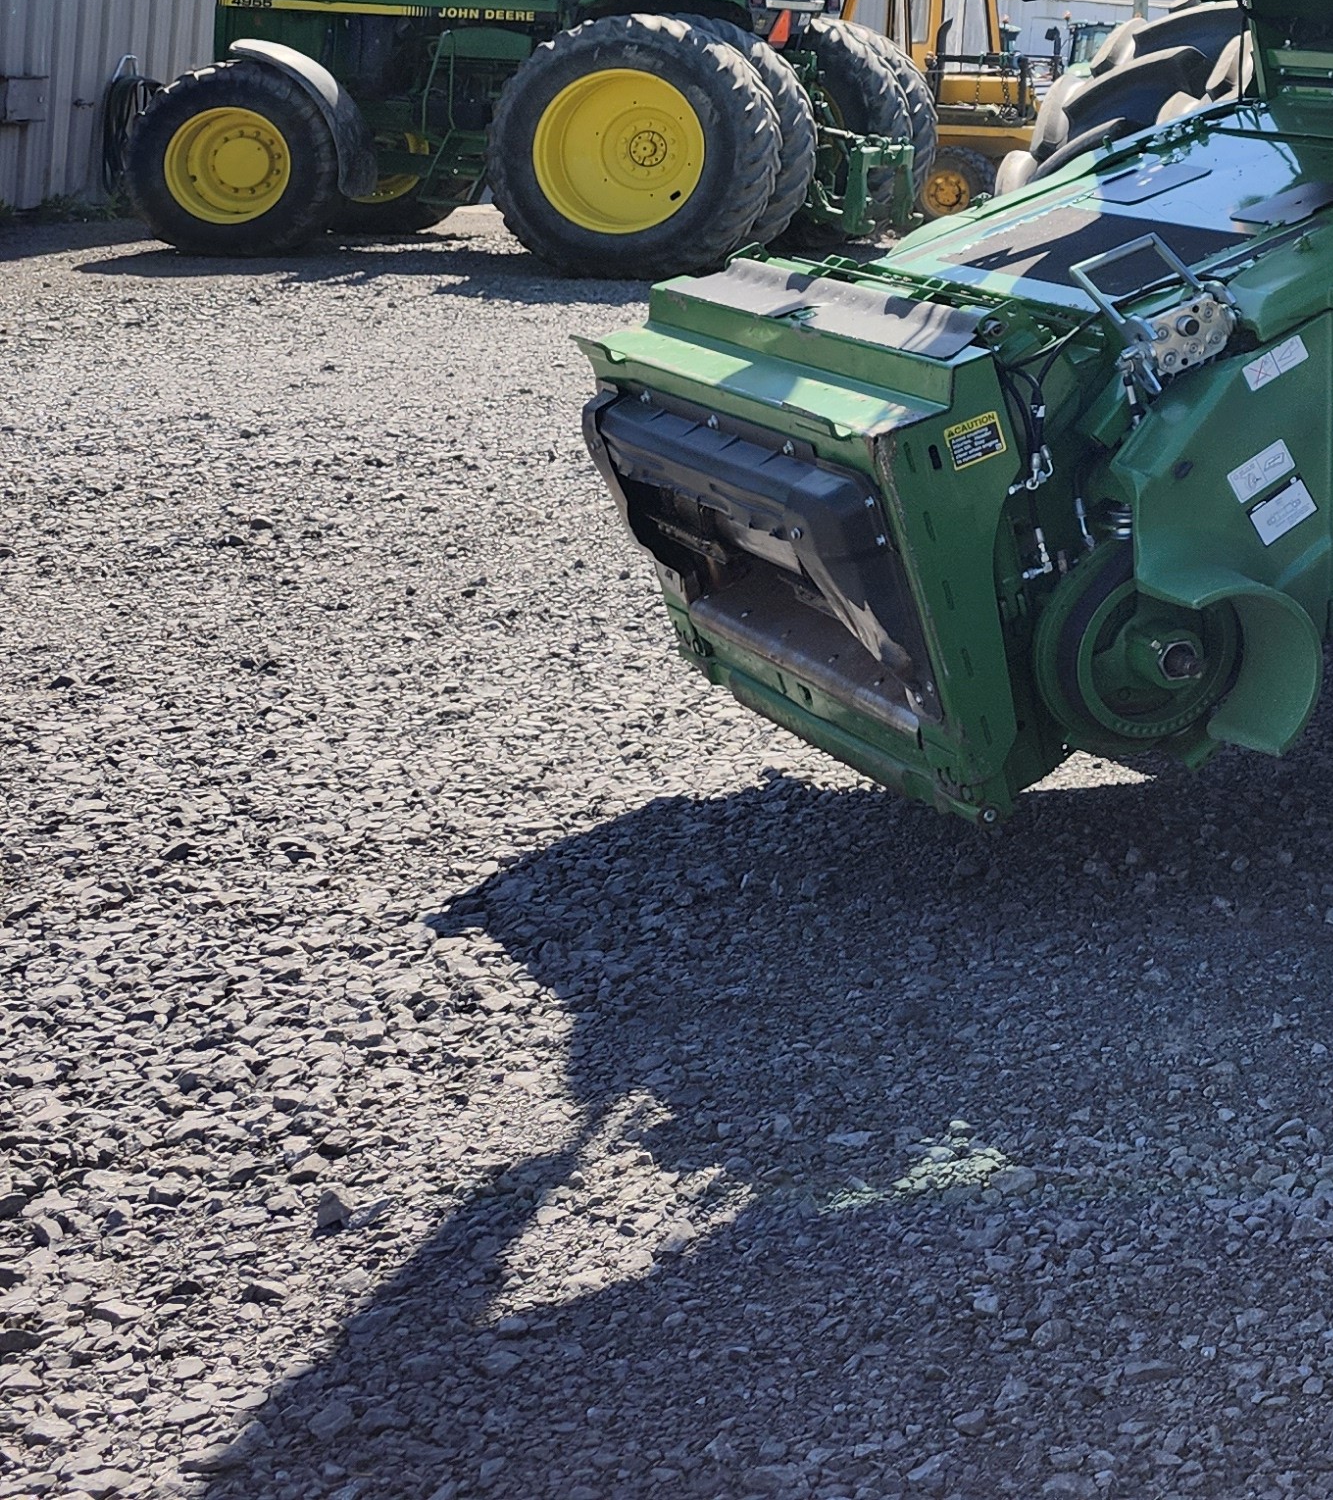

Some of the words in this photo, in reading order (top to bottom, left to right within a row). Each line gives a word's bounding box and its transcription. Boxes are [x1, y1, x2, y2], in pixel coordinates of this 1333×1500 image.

[438, 6, 480, 19] JOHN
[485, 8, 535, 22] DEERE
[954, 413, 995, 435] CAUTION
